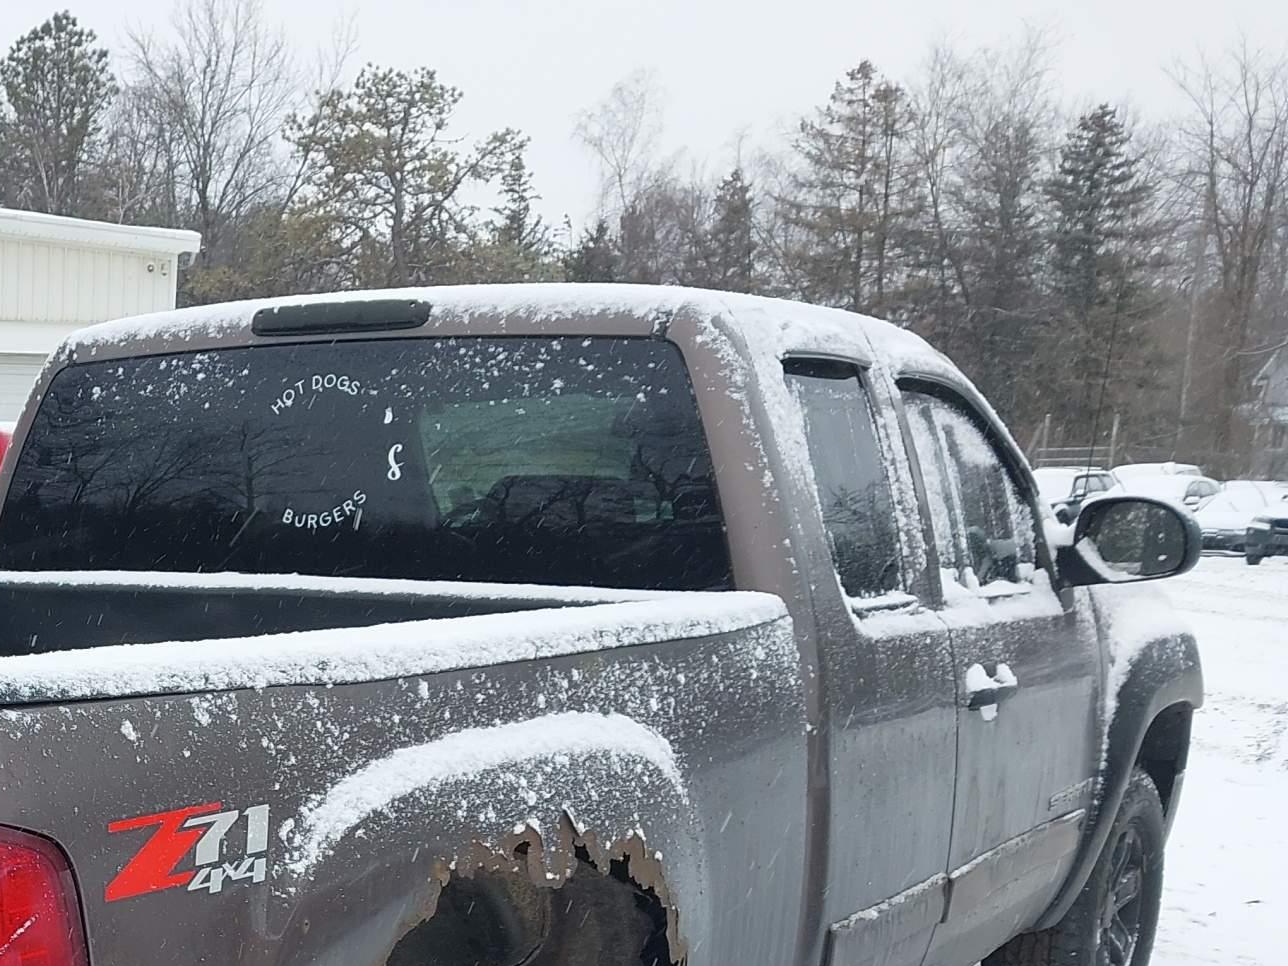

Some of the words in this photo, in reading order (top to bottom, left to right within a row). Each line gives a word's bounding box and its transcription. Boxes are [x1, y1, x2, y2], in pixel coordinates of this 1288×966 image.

[271, 379, 305, 415] HOT
[312, 374, 360, 396] DOGS
[282, 490, 367, 529] BURGERS
[105, 802, 270, 902] Z71
